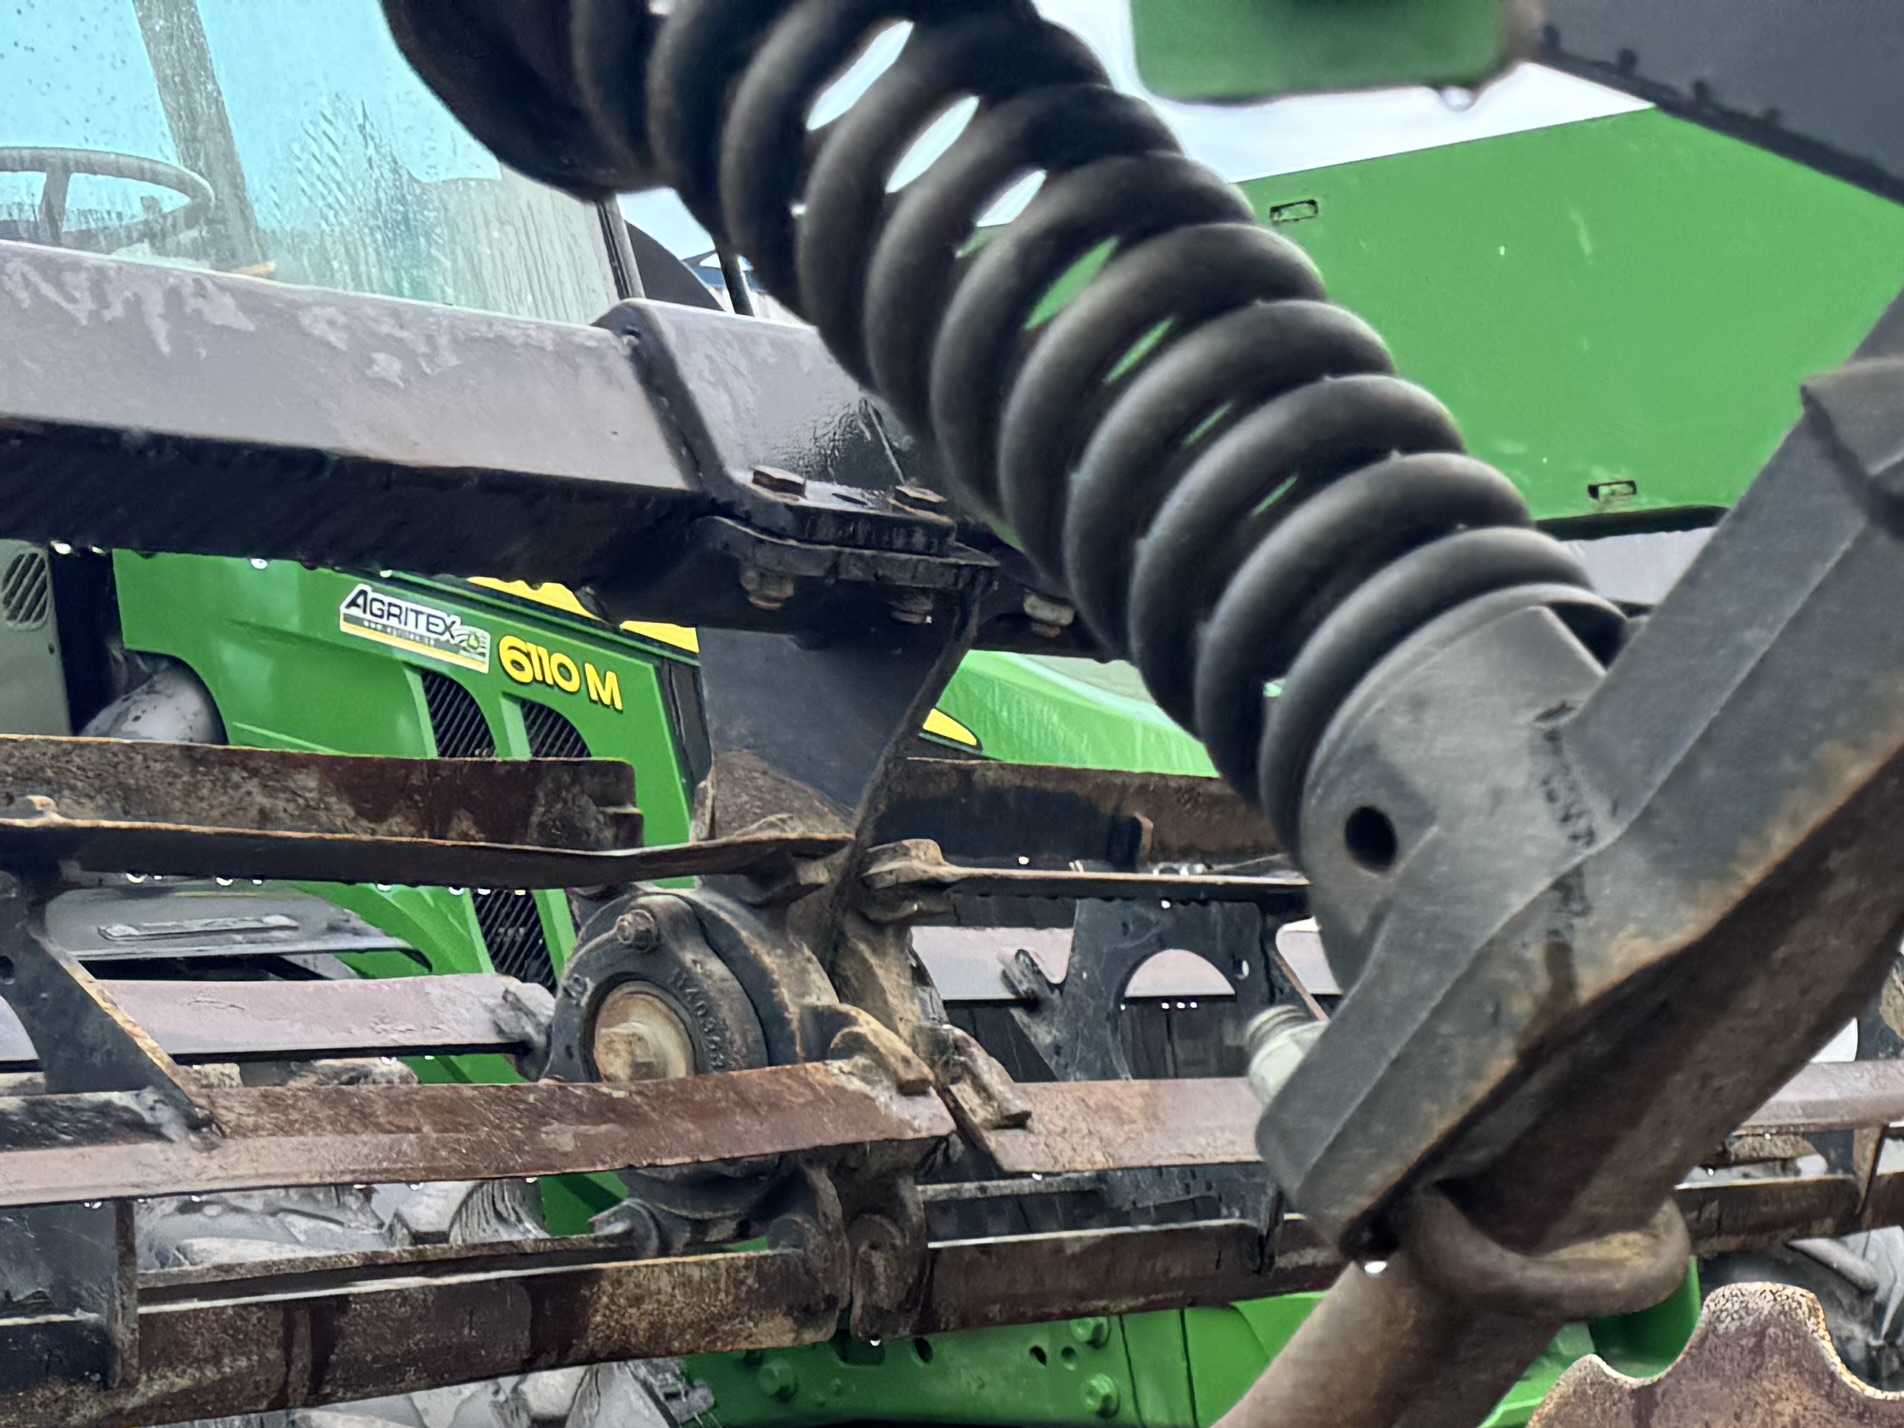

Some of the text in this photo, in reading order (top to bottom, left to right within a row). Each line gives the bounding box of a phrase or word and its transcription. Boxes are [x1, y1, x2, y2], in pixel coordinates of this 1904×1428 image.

[345, 588, 457, 641] AGRITEX
[499, 635, 623, 711] 6110 M
